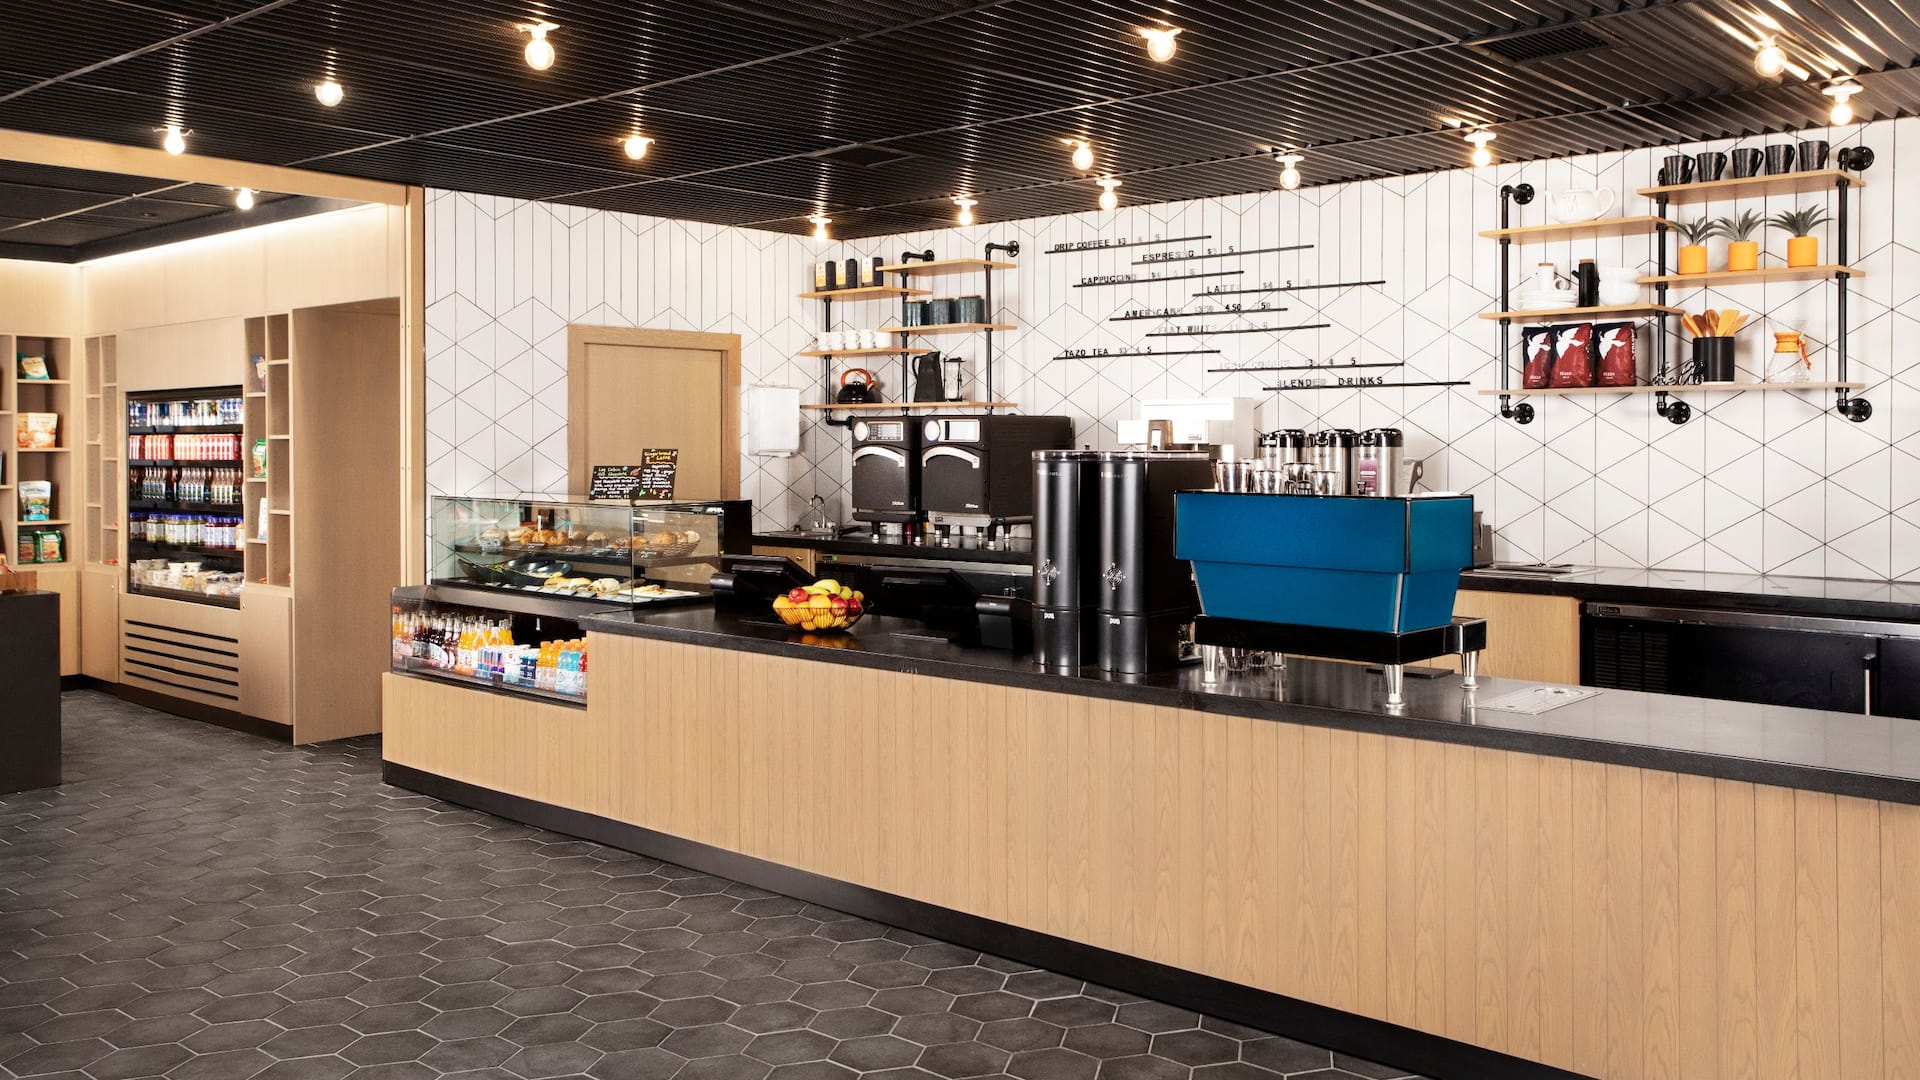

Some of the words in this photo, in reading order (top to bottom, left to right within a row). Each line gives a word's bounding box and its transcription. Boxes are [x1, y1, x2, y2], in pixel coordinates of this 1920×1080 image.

[1055, 243, 1074, 251] DRIP
[1076, 239, 1111, 250] COFFEE
[1081, 273, 1137, 286] CAPPUCCINO
[1286, 280, 1292, 289] 5
[1064, 350, 1087, 359] TAZO
[1092, 348, 1109, 357] TEA
[1350, 356, 1356, 365] 5
[1276, 377, 1327, 388] BLENDED
[1338, 376, 1384, 387] DRINKS
